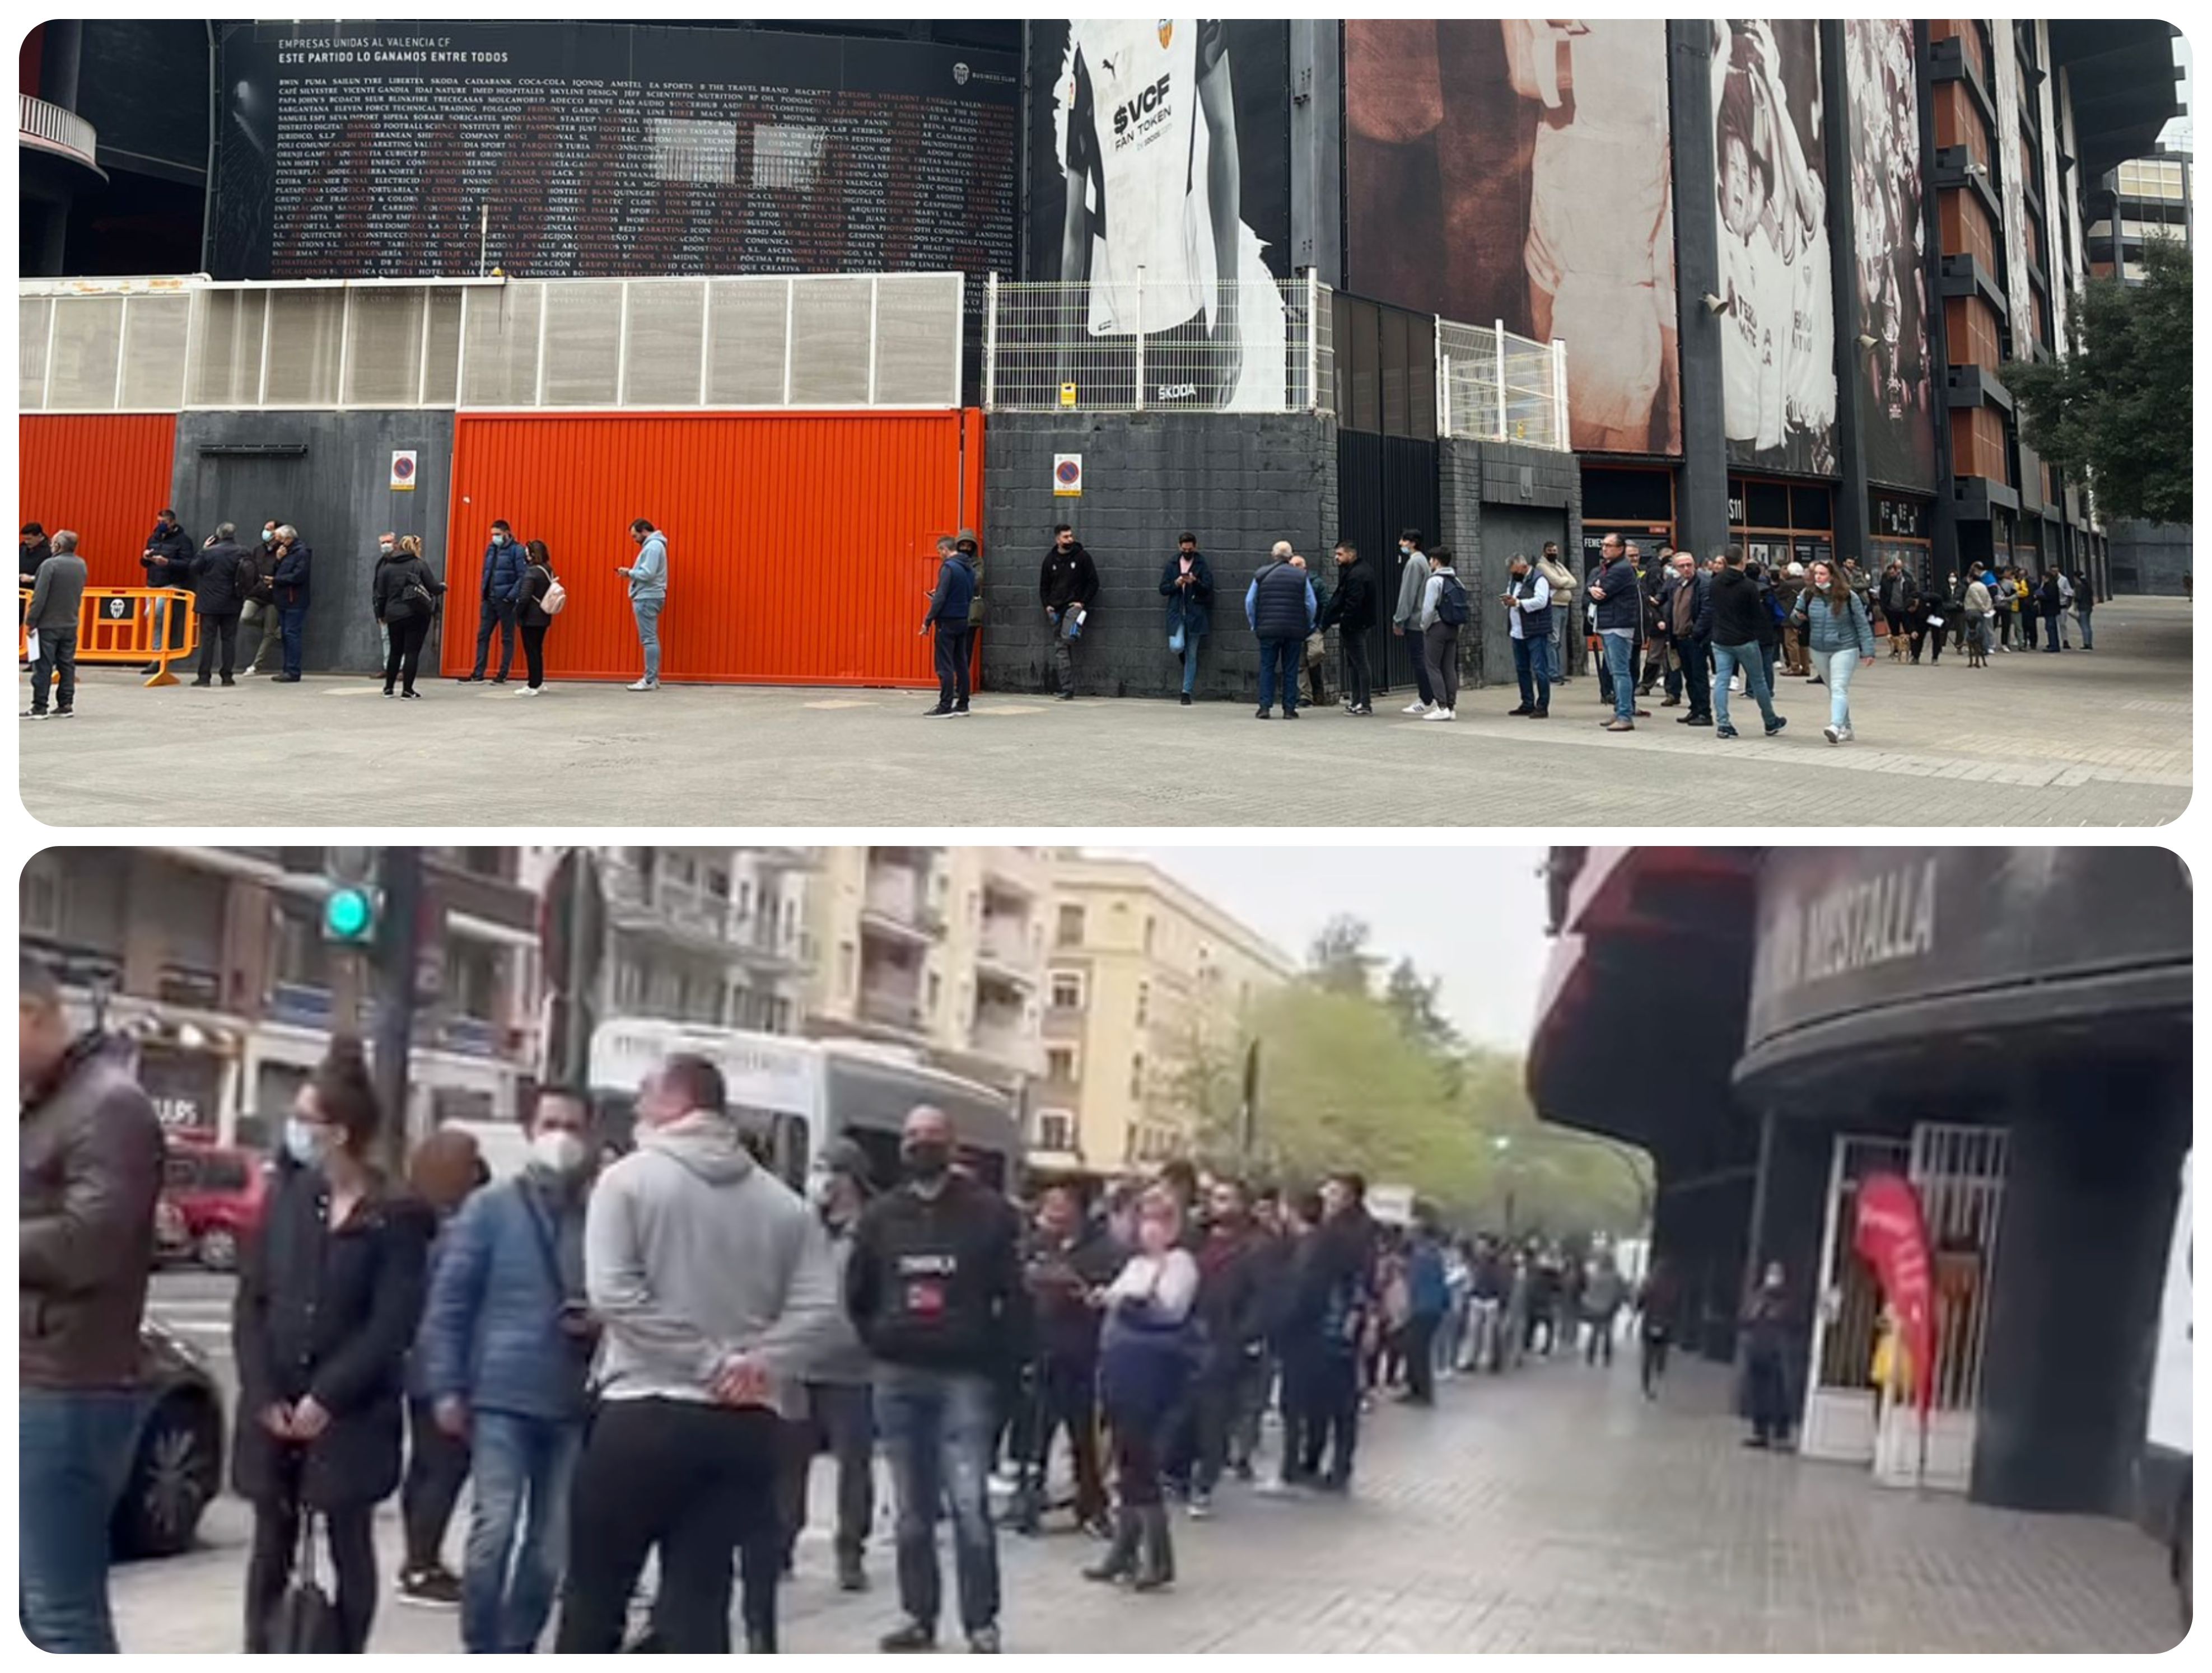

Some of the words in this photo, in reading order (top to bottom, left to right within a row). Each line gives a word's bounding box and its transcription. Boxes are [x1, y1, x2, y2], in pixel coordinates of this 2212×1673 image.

[279, 39, 330, 49] EMPRESAS
[334, 38, 368, 48] UNIDAS
[372, 38, 384, 46] AL
[388, 37, 435, 47] VALENCIA
[438, 37, 451, 47] CF
[279, 53, 305, 63] ESTE
[308, 52, 353, 63] PARTIDO
[357, 52, 371, 62] LO
[375, 52, 427, 62] GANAMOS
[431, 52, 468, 62] ENTRE
[472, 52, 508, 62] TODOS
[278, 86, 297, 95] CAFÉ
[573, 79, 604, 87] IQONIQ
[795, 88, 831, 96] HACKETT
[669, 100, 717, 109] SOCCERHUB
[1114, 73, 1170, 135] $VCF
[1115, 130, 1134, 151] FAN
[1137, 105, 1171, 135] TOKEN
[872, 170, 889, 179] AND
[845, 179, 883, 188] VALENCIA
[1584, 538, 1606, 548] FEME
[1807, 859, 1937, 983] MESTALLA
